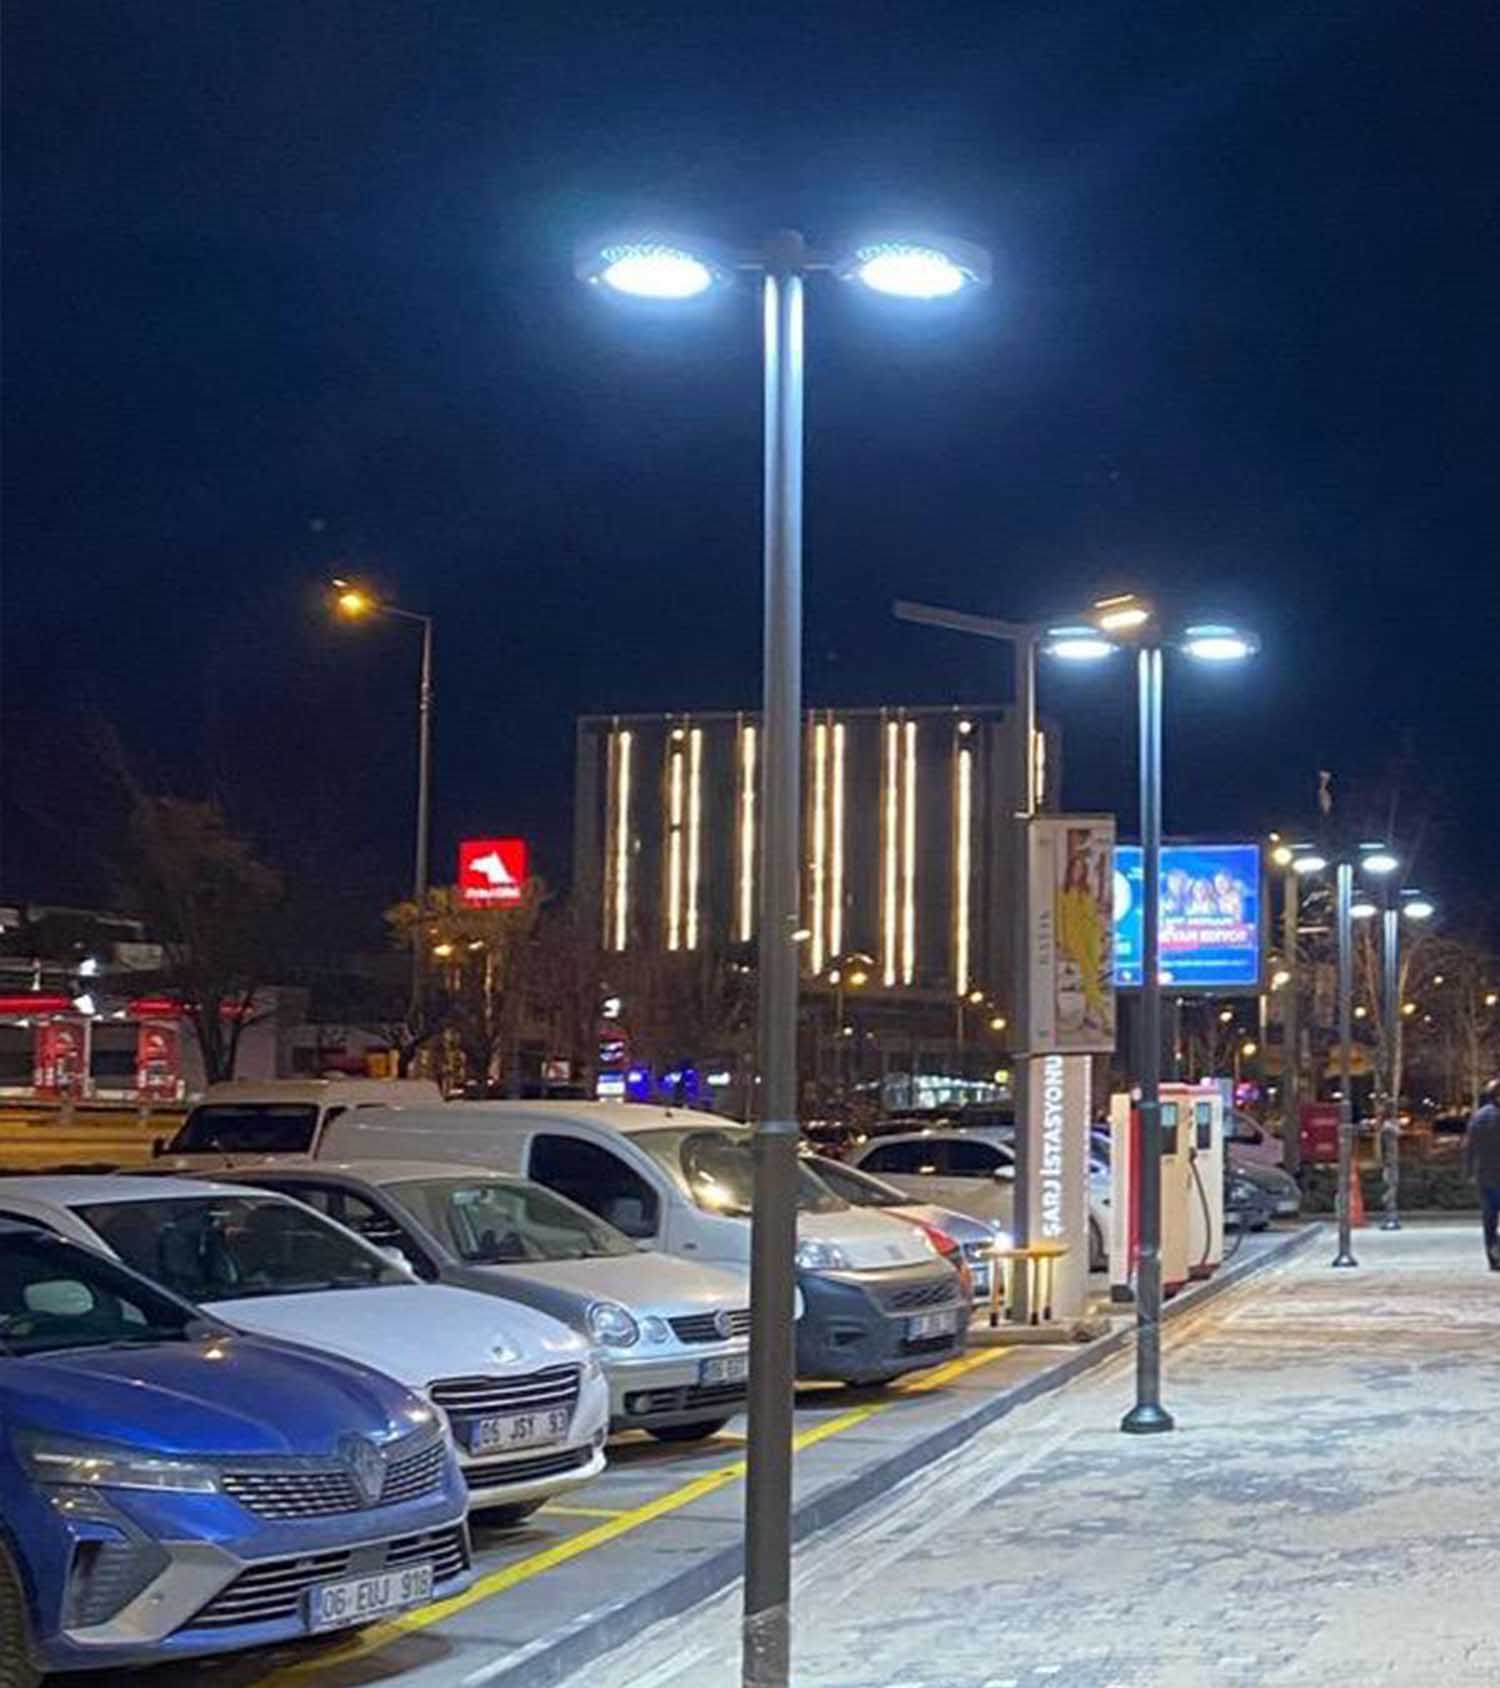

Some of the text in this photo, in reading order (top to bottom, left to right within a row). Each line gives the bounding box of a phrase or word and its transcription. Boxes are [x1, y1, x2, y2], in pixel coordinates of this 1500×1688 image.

[1039, 1055, 1065, 1236] ŞARJ İSTASYONU
[322, 1587, 346, 1618] 06
